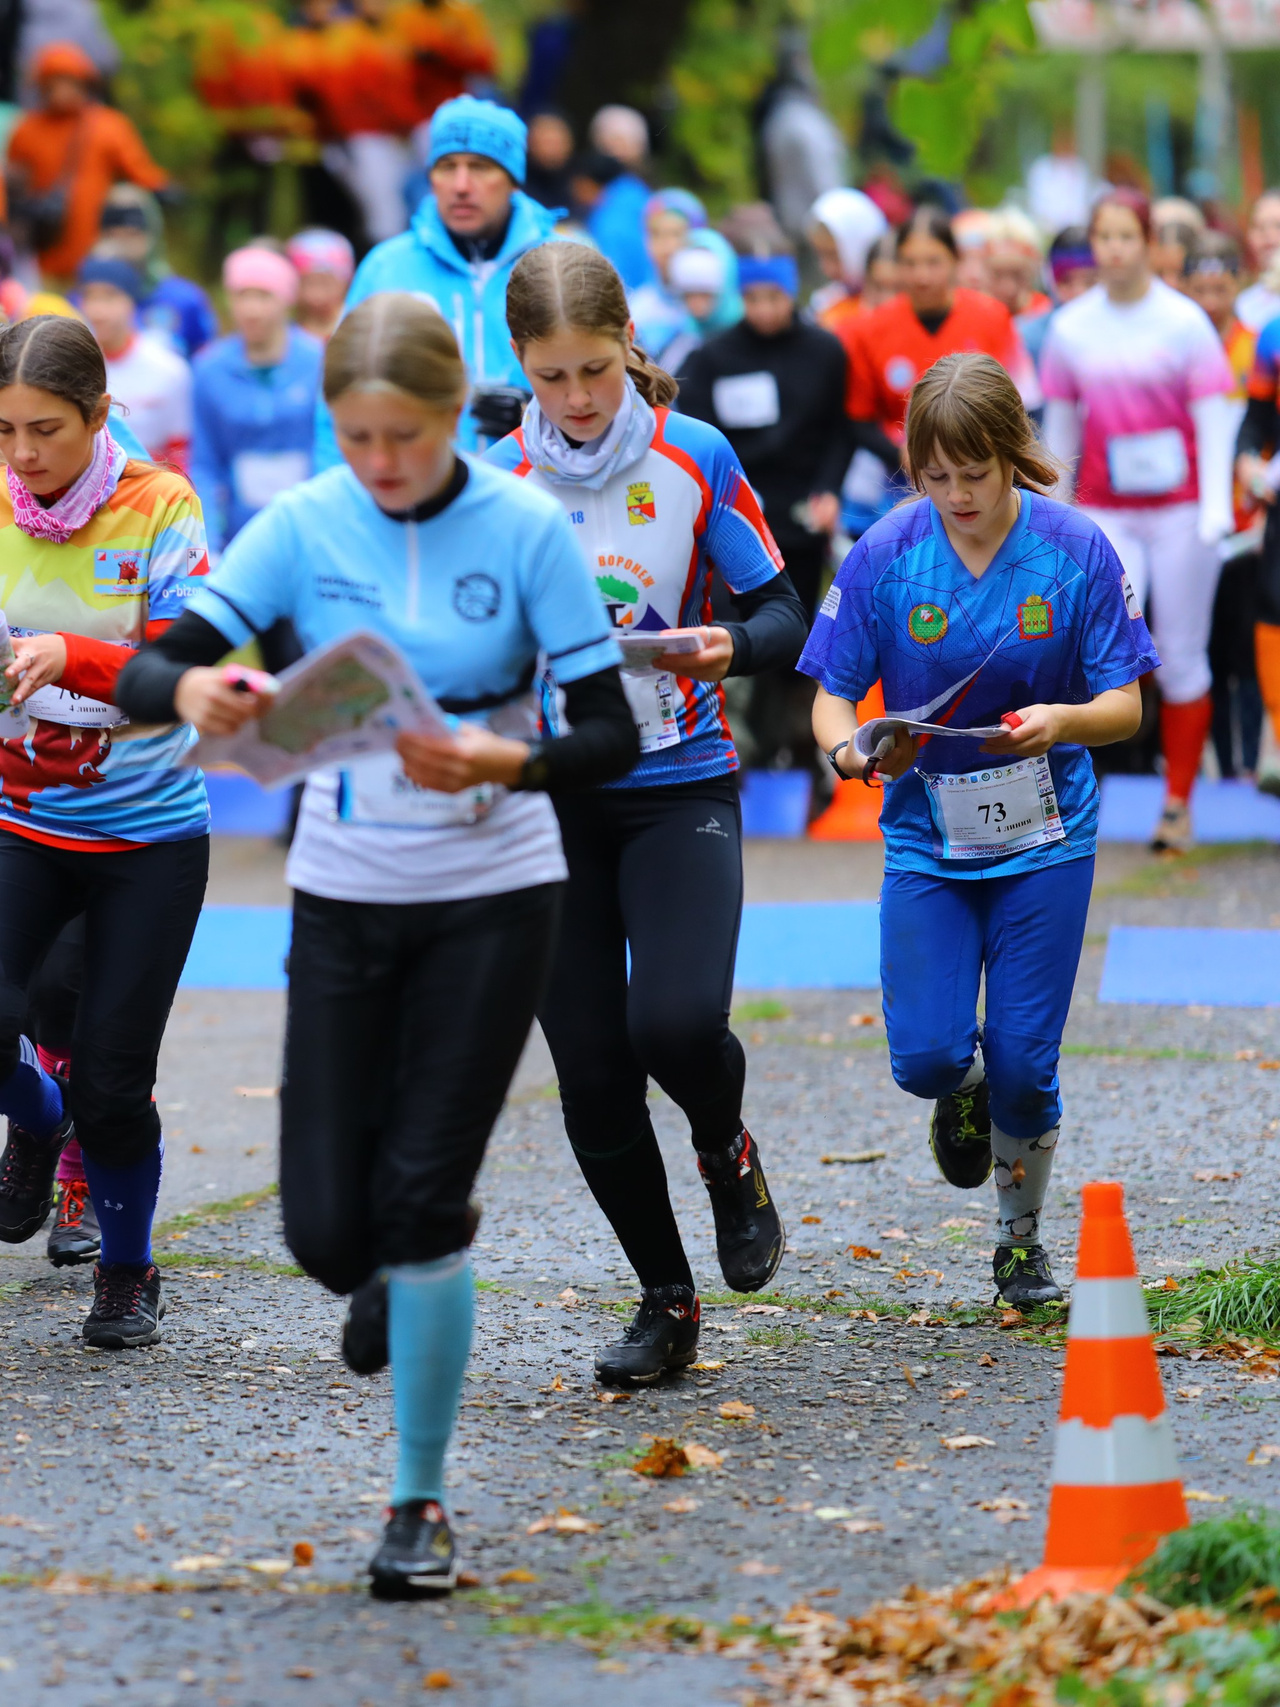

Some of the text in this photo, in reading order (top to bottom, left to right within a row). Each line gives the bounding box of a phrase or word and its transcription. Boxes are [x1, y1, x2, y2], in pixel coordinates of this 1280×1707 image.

[188, 550, 197, 559] 34
[597, 554, 656, 588] ВОРОНЕЖ
[162, 583, 204, 599] o-bizo
[68, 704, 74, 712] 4
[977, 801, 1007, 824] 73
[995, 818, 1032, 833] 4 линия
